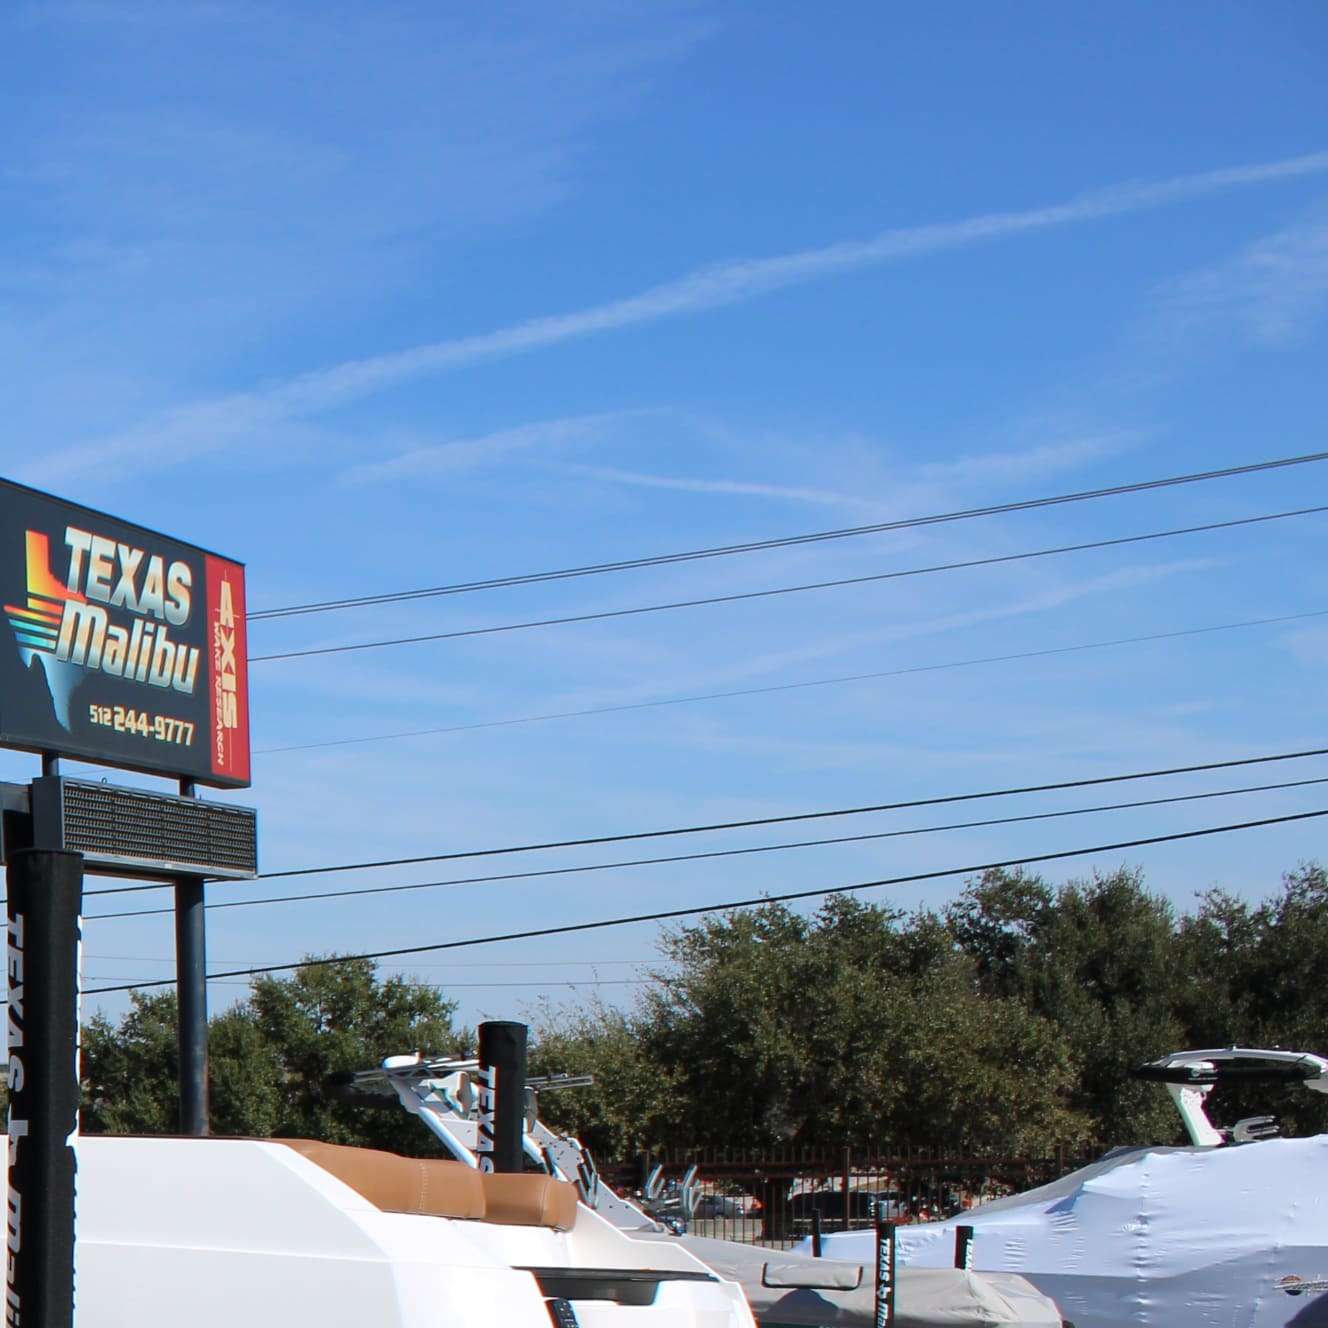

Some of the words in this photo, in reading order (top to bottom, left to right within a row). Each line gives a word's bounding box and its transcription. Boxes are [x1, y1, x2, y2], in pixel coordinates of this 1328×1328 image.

[64, 526, 193, 626] TEXAS
[55, 599, 200, 694] Malibu
[219, 580, 238, 729] AXIS
[89, 704, 112, 726] 512
[113, 706, 194, 746] 244-9777
[879, 1238, 891, 1281] TEXAS
